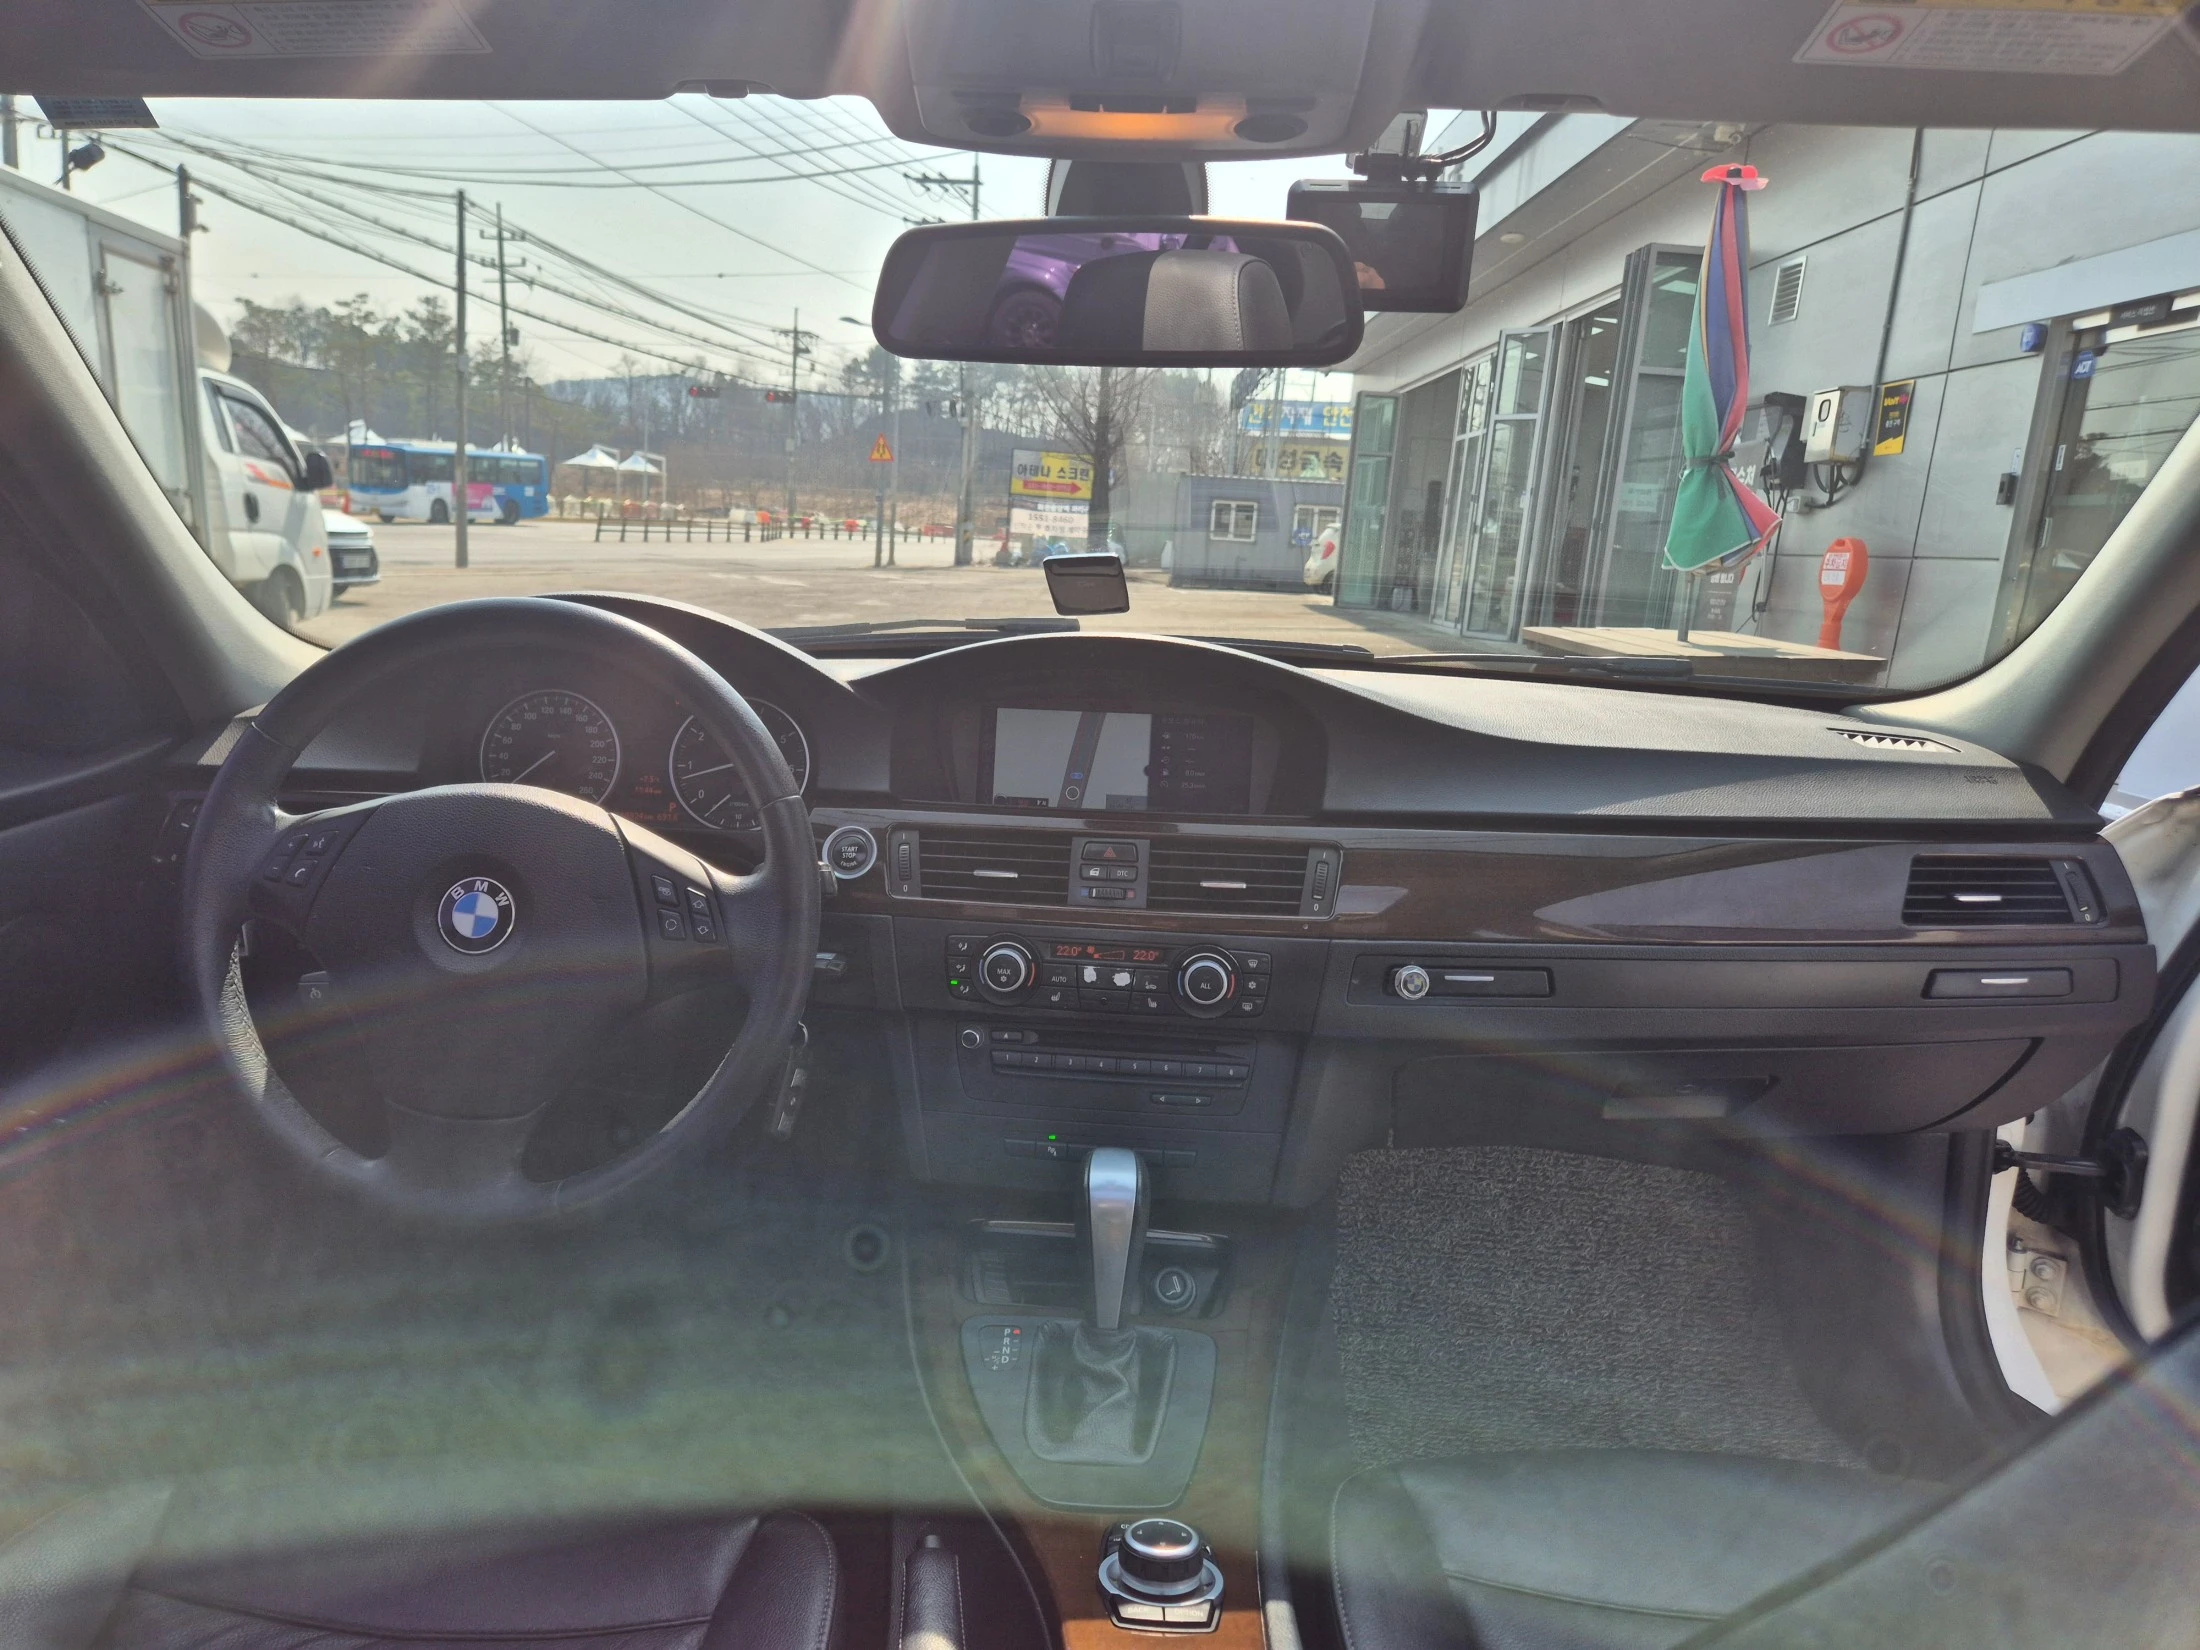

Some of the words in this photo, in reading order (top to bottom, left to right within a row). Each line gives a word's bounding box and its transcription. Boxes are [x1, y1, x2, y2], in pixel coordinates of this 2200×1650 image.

[2075, 361, 2092, 375] ADT
[1017, 464, 1050, 478] 아테나
[560, 707, 572, 715] 140
[524, 712, 537, 720] 100
[511, 723, 522, 731] 80
[698, 732, 705, 741] 2
[780, 736, 787, 744] 5
[590, 740, 605, 748] 200
[499, 752, 509, 760] 40
[592, 756, 607, 764] 220
[687, 761, 693, 769] 1
[501, 768, 511, 776] 20
[698, 790, 705, 799] 0
[669, 803, 677, 812] P
[903, 884, 908, 893] 0
[450, 880, 510, 907] BMW
[1313, 903, 1319, 911] 0
[996, 967, 1011, 975] MAX
[1051, 975, 1067, 983] AUTO
[1200, 981, 1212, 989] ALL
[1068, 1058, 1073, 1066] 3
[1004, 1328, 1011, 1337] P
[1003, 1337, 1010, 1345] R
[1002, 1346, 1010, 1354] N
[1001, 1355, 1009, 1364] D
[1174, 1609, 1204, 1617] OPTION
